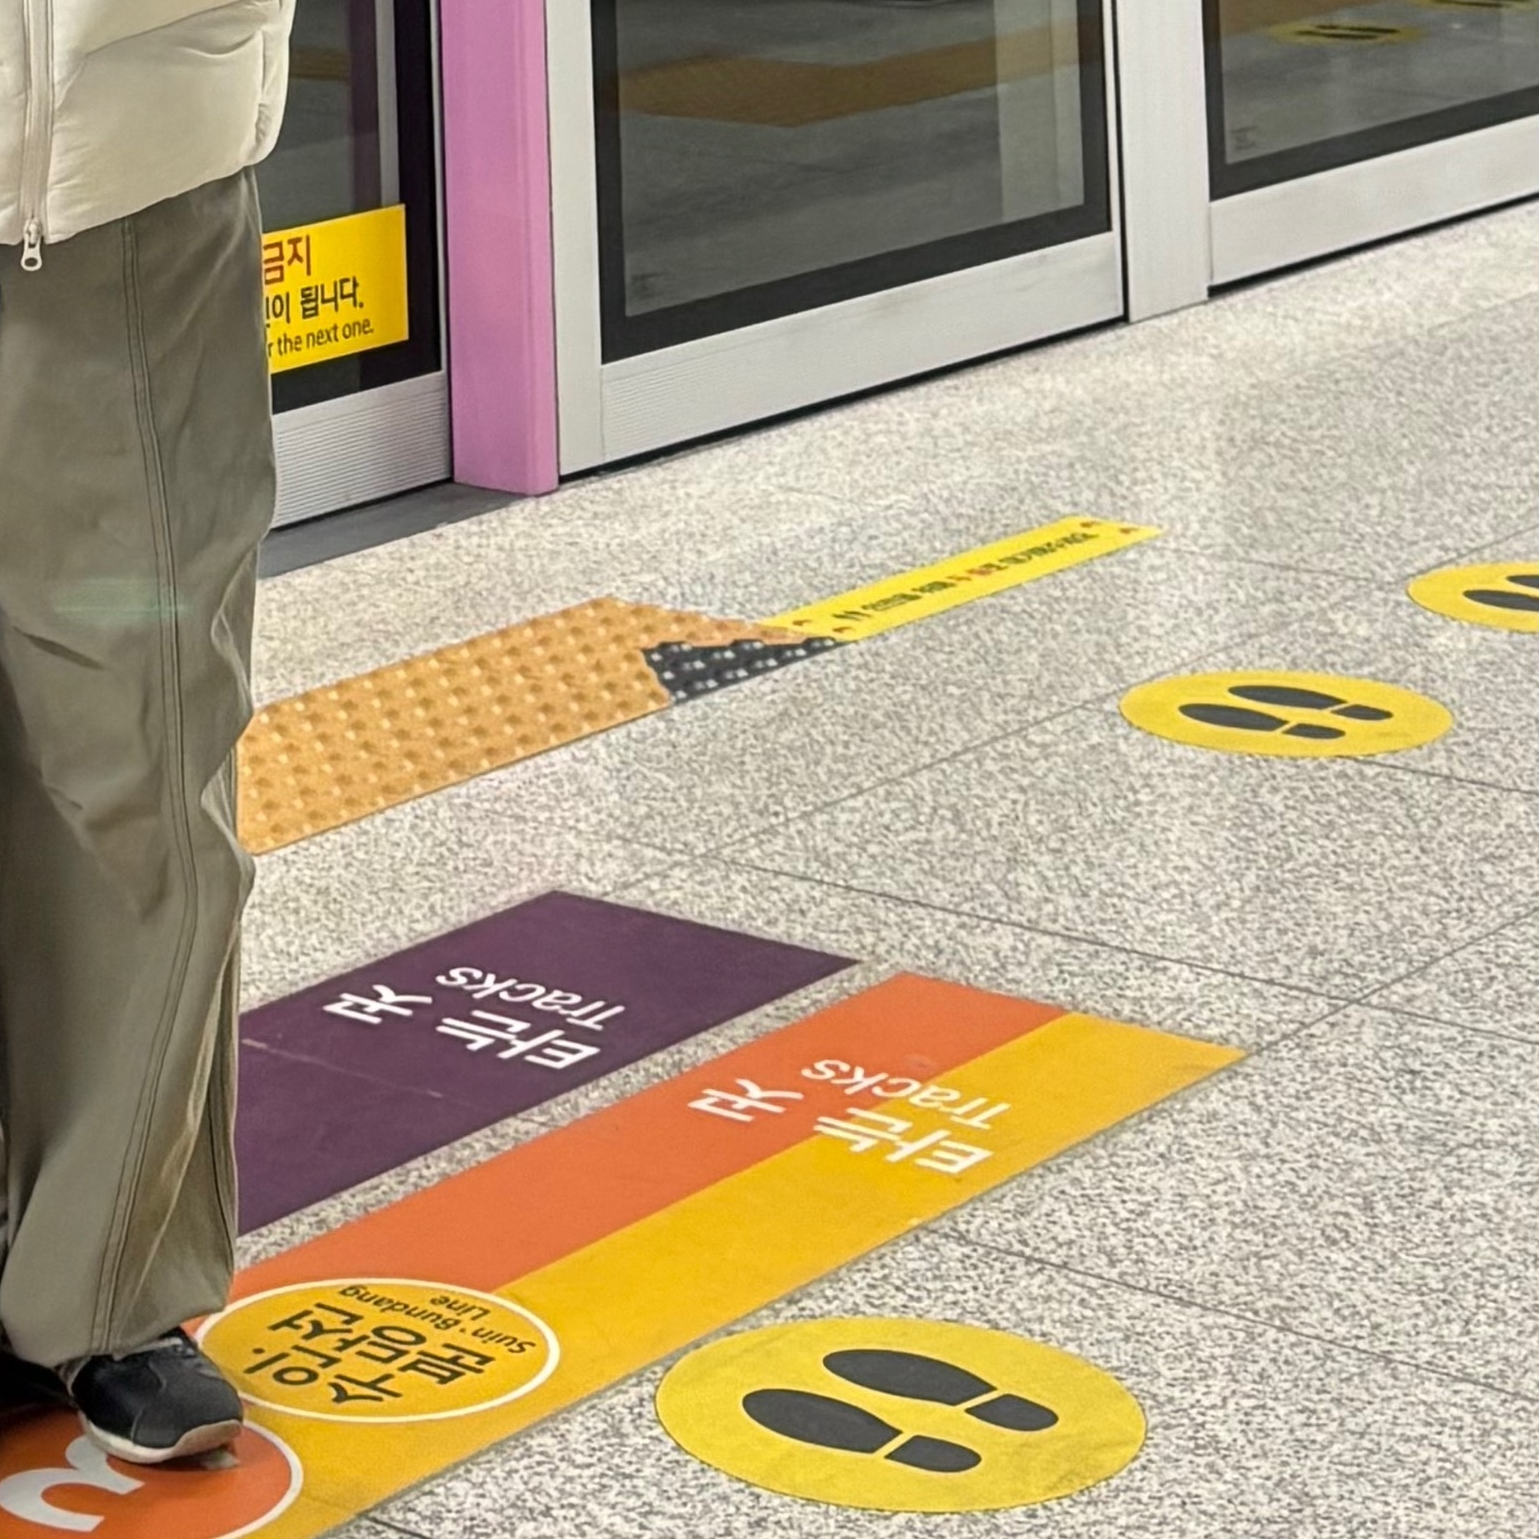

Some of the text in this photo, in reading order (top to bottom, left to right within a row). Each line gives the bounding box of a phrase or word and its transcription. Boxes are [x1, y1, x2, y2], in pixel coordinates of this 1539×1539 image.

[263, 234, 312, 286] 금지
[300, 276, 364, 320] 됩니다.
[277, 330, 303, 357] the
[306, 323, 339, 349] next
[341, 317, 374, 340] one.
[322, 984, 601, 1070] 타는 곳
[435, 966, 625, 1031] Tracks
[687, 1078, 994, 1174] 타는 곳
[801, 1059, 1012, 1130] Tracks
[430, 1294, 491, 1323] Line
[266, 1302, 496, 1385] 분당선
